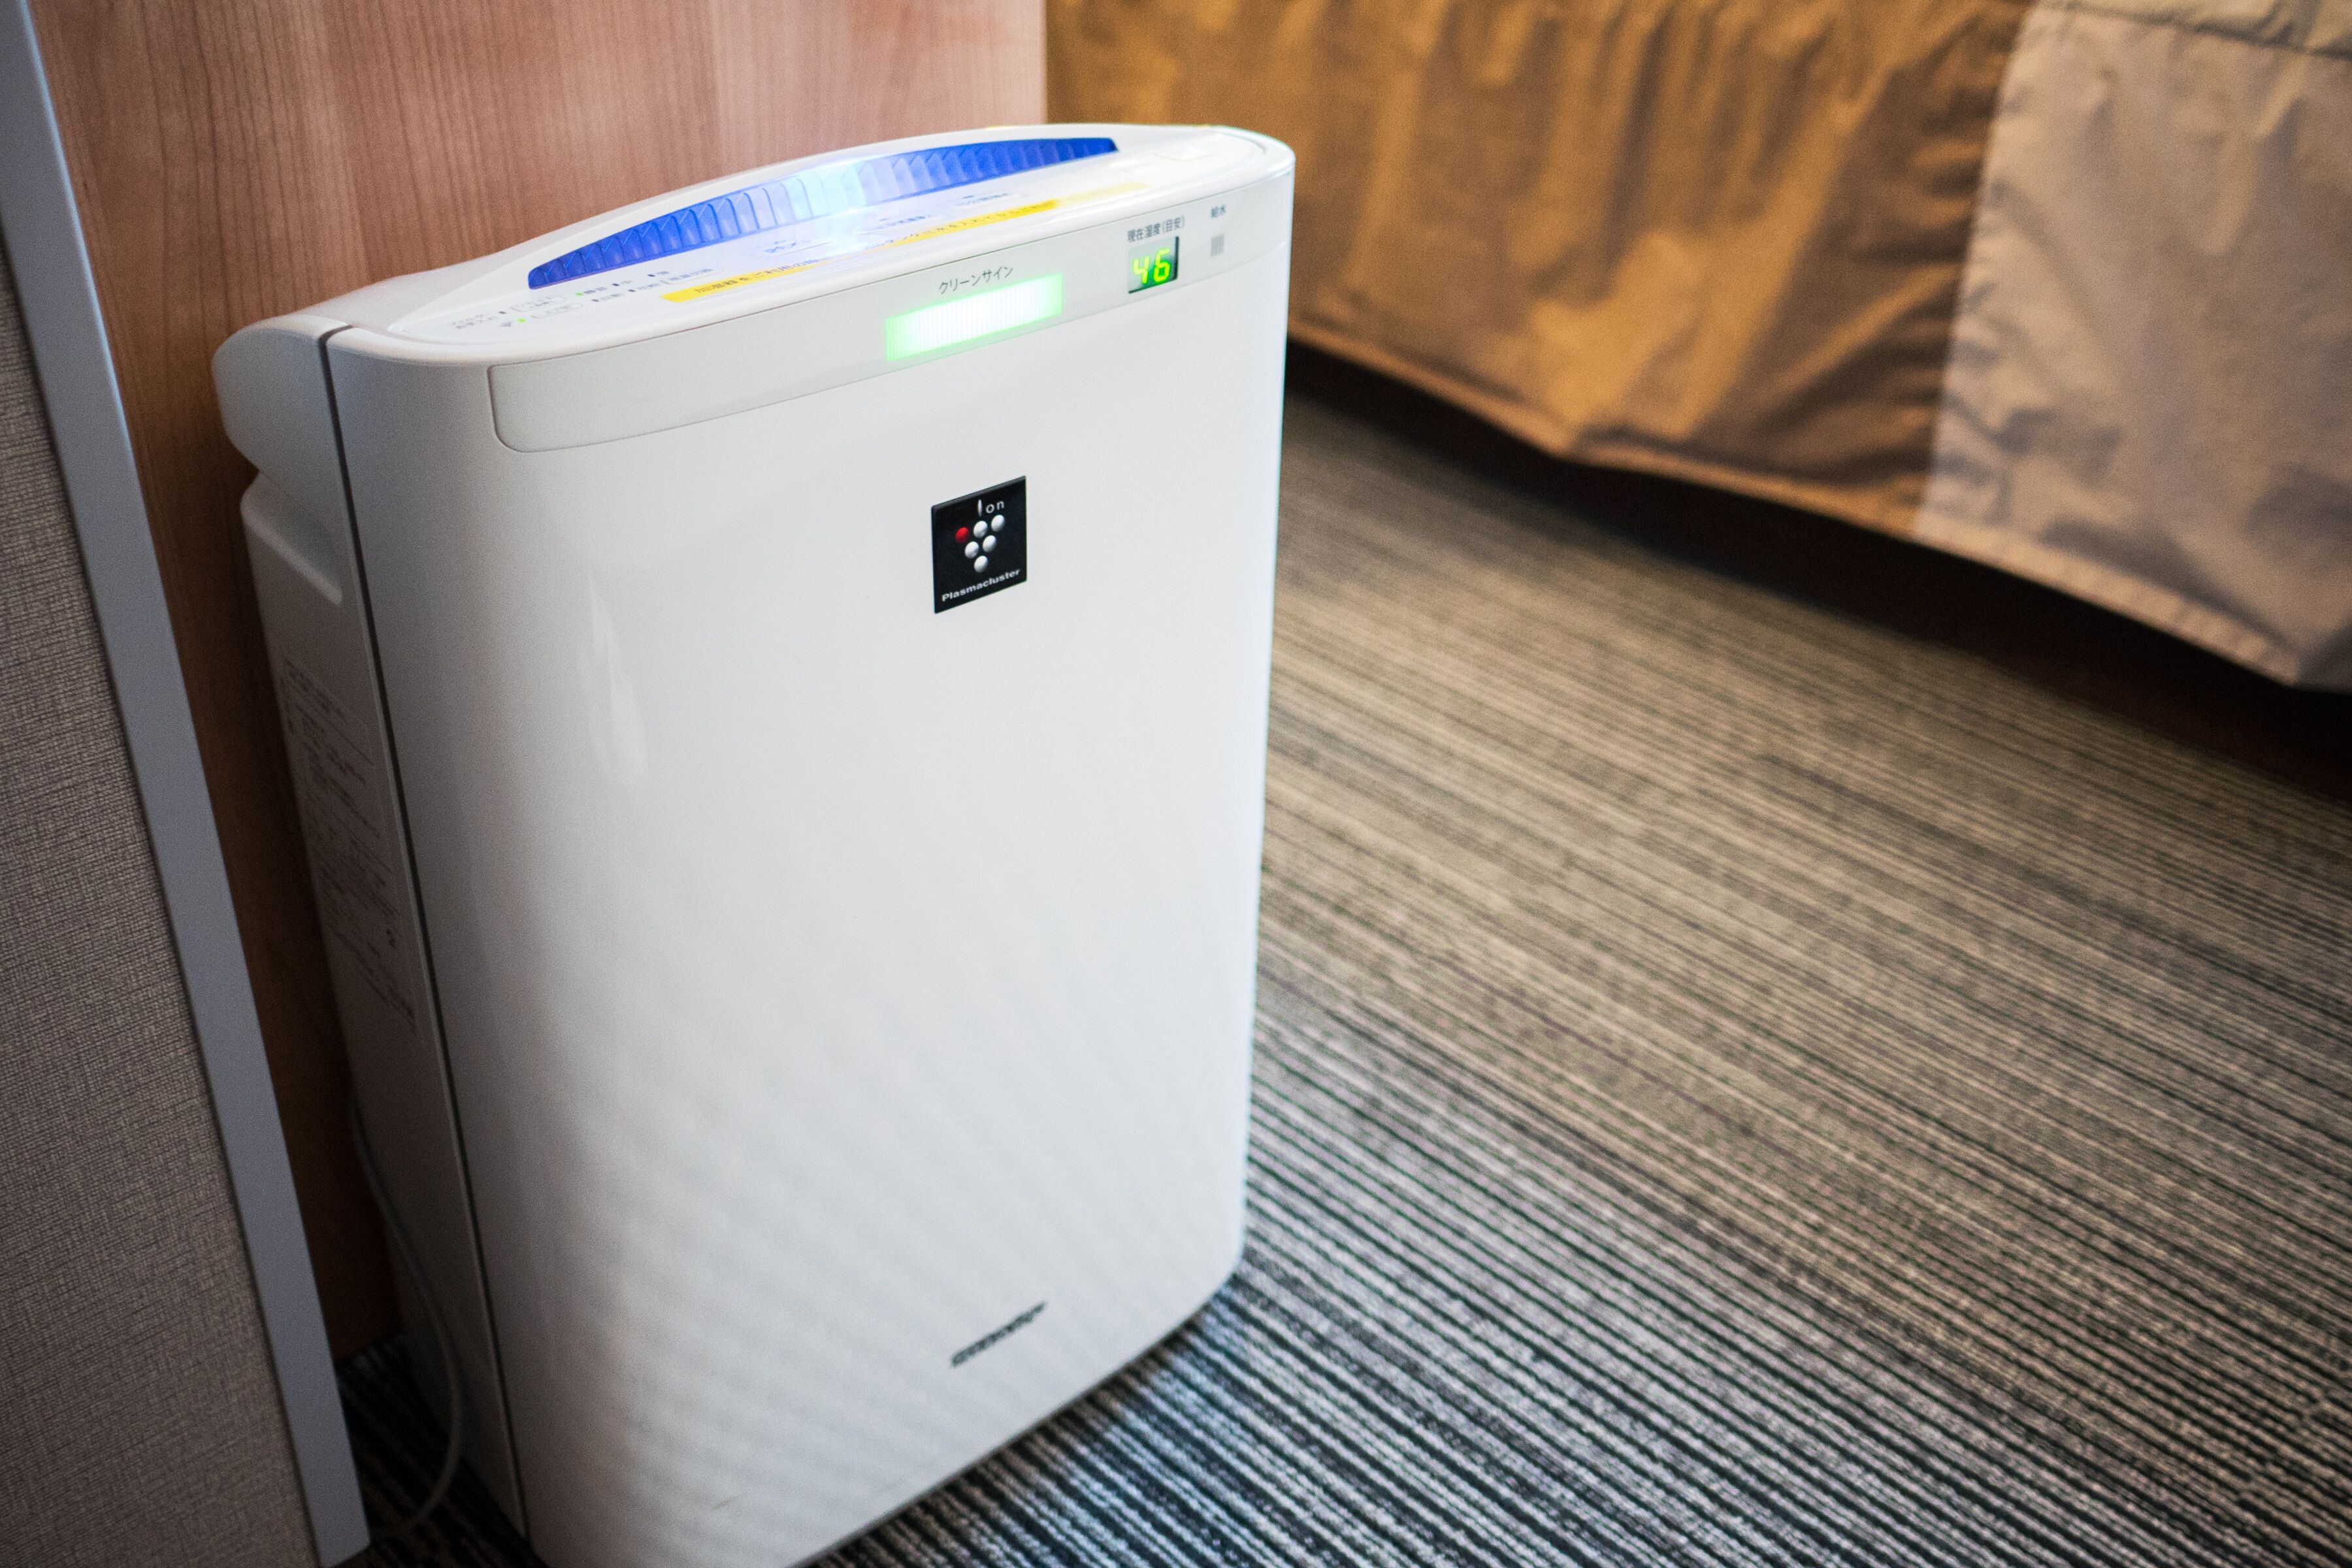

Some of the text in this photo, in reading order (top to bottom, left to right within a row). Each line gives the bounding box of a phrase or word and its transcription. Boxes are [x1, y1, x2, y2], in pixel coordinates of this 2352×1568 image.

[939, 266, 1013, 295] クリーンサイン
[1132, 248, 1171, 284] 46
[977, 499, 1005, 517] Ion
[941, 569, 1021, 602] Plasmacluster
